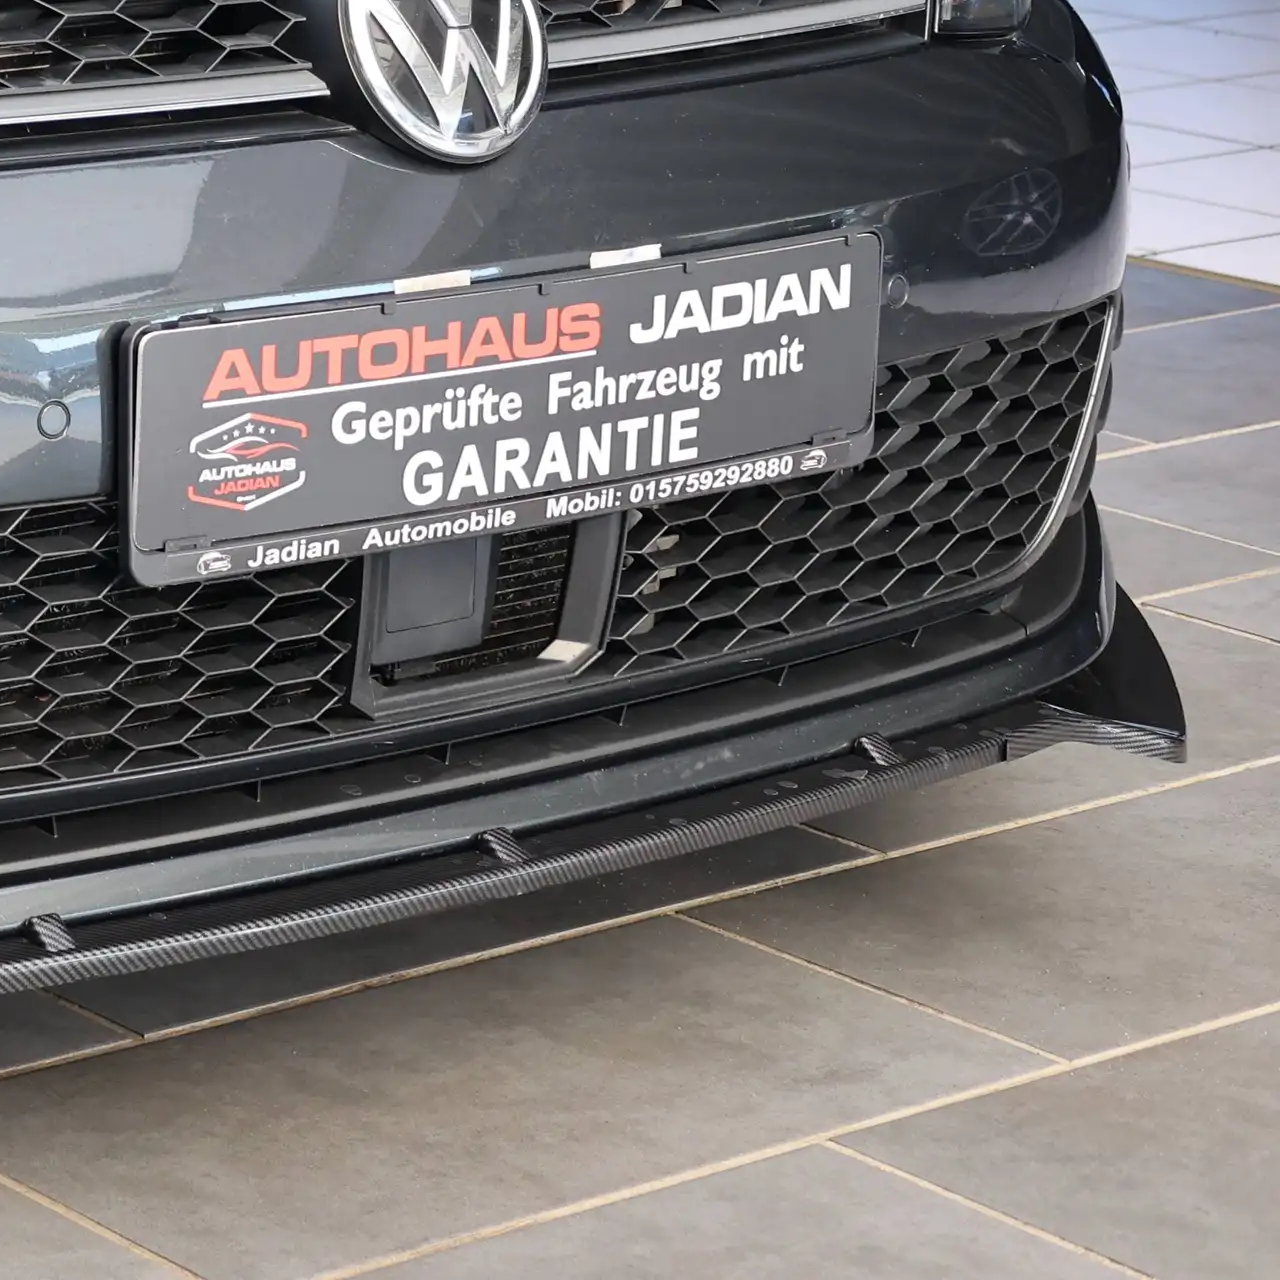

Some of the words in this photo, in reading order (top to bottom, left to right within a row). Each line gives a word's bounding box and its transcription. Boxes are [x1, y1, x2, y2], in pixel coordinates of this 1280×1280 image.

[202, 302, 602, 401] AUTOHAUS
[629, 263, 852, 345] JADIAN
[331, 384, 523, 450] Geprüfte
[547, 357, 723, 414] Fahrzeug
[743, 334, 805, 382] mit
[199, 458, 297, 482] AUTOHAUS
[214, 476, 281, 495] JADIAN
[403, 407, 701, 506] GARANTIE
[247, 538, 340, 569] Jadian
[361, 507, 517, 550] Automobile
[545, 487, 622, 520] Mobil:
[629, 455, 794, 505] 015759292880
